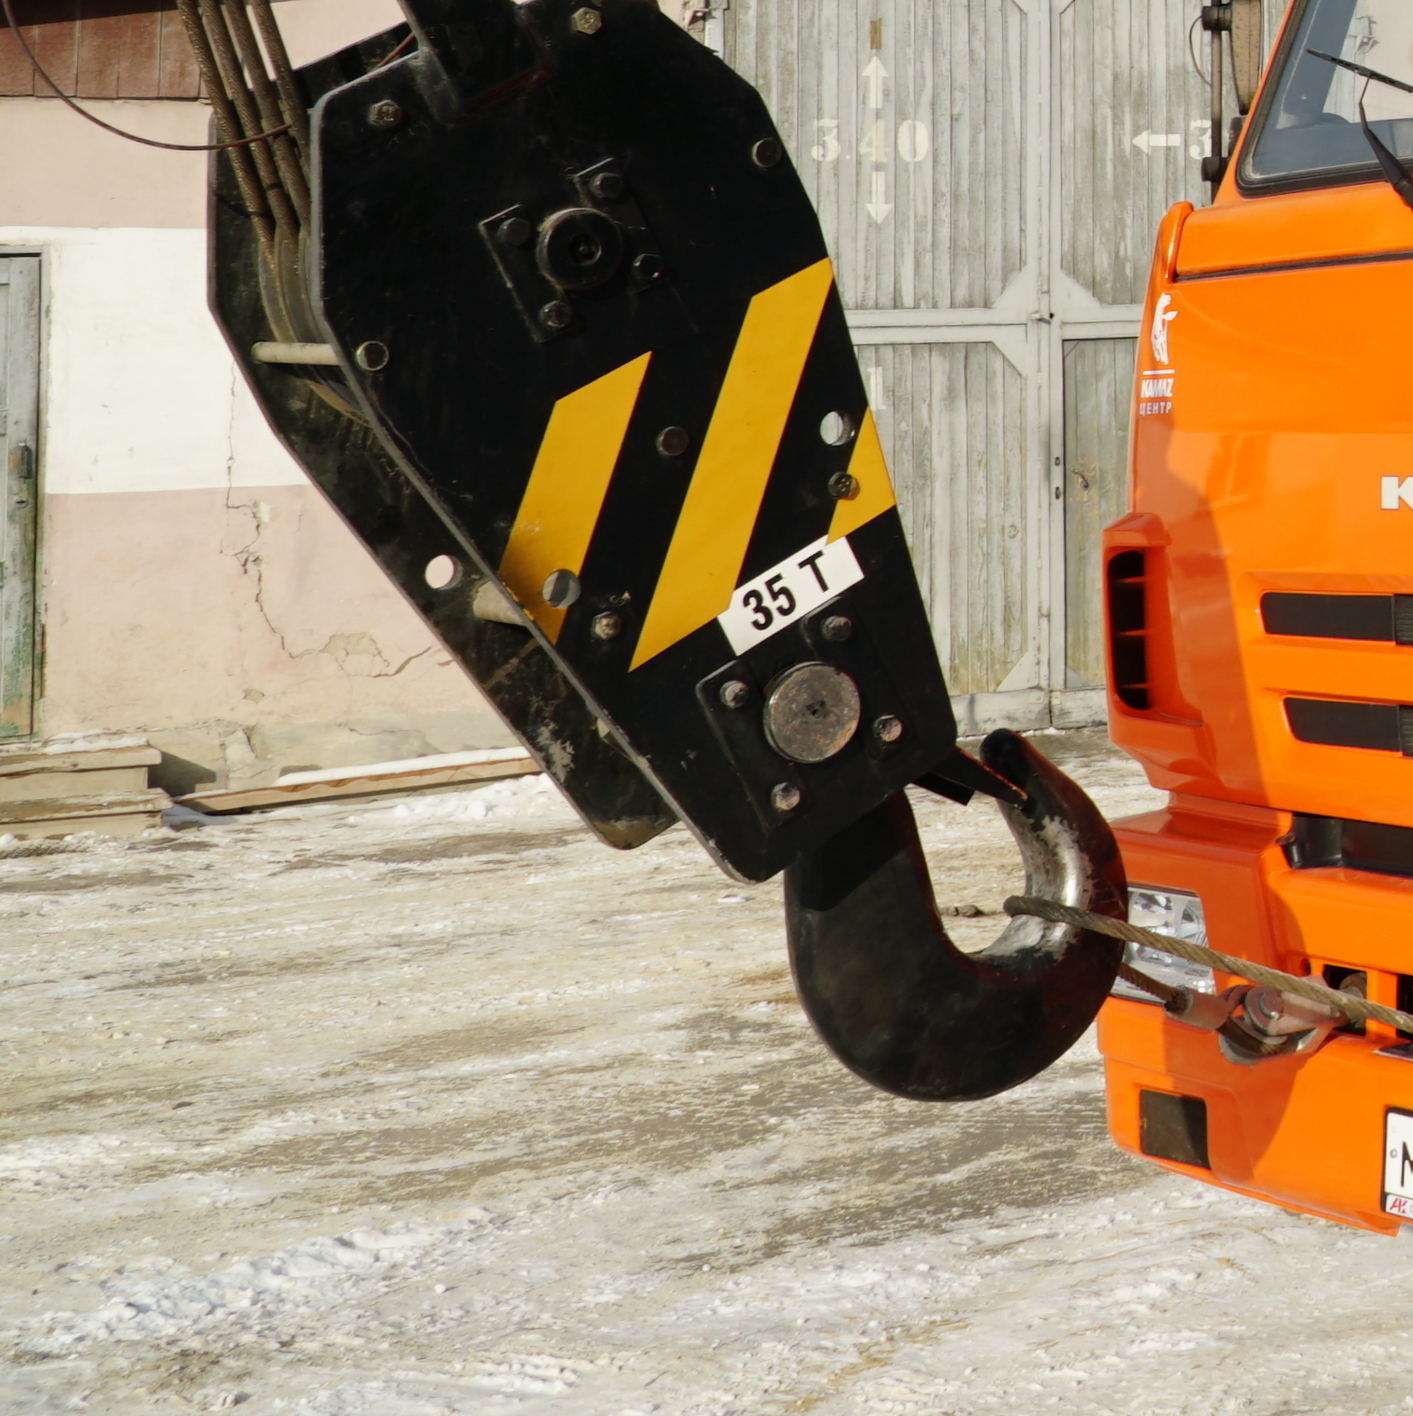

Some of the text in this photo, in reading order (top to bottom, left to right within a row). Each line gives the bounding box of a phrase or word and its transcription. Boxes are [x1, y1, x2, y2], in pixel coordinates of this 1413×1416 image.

[1140, 378, 1174, 398] KAMAZ
[1139, 401, 1172, 417] ЦЕНТР
[742, 575, 797, 632] 35
